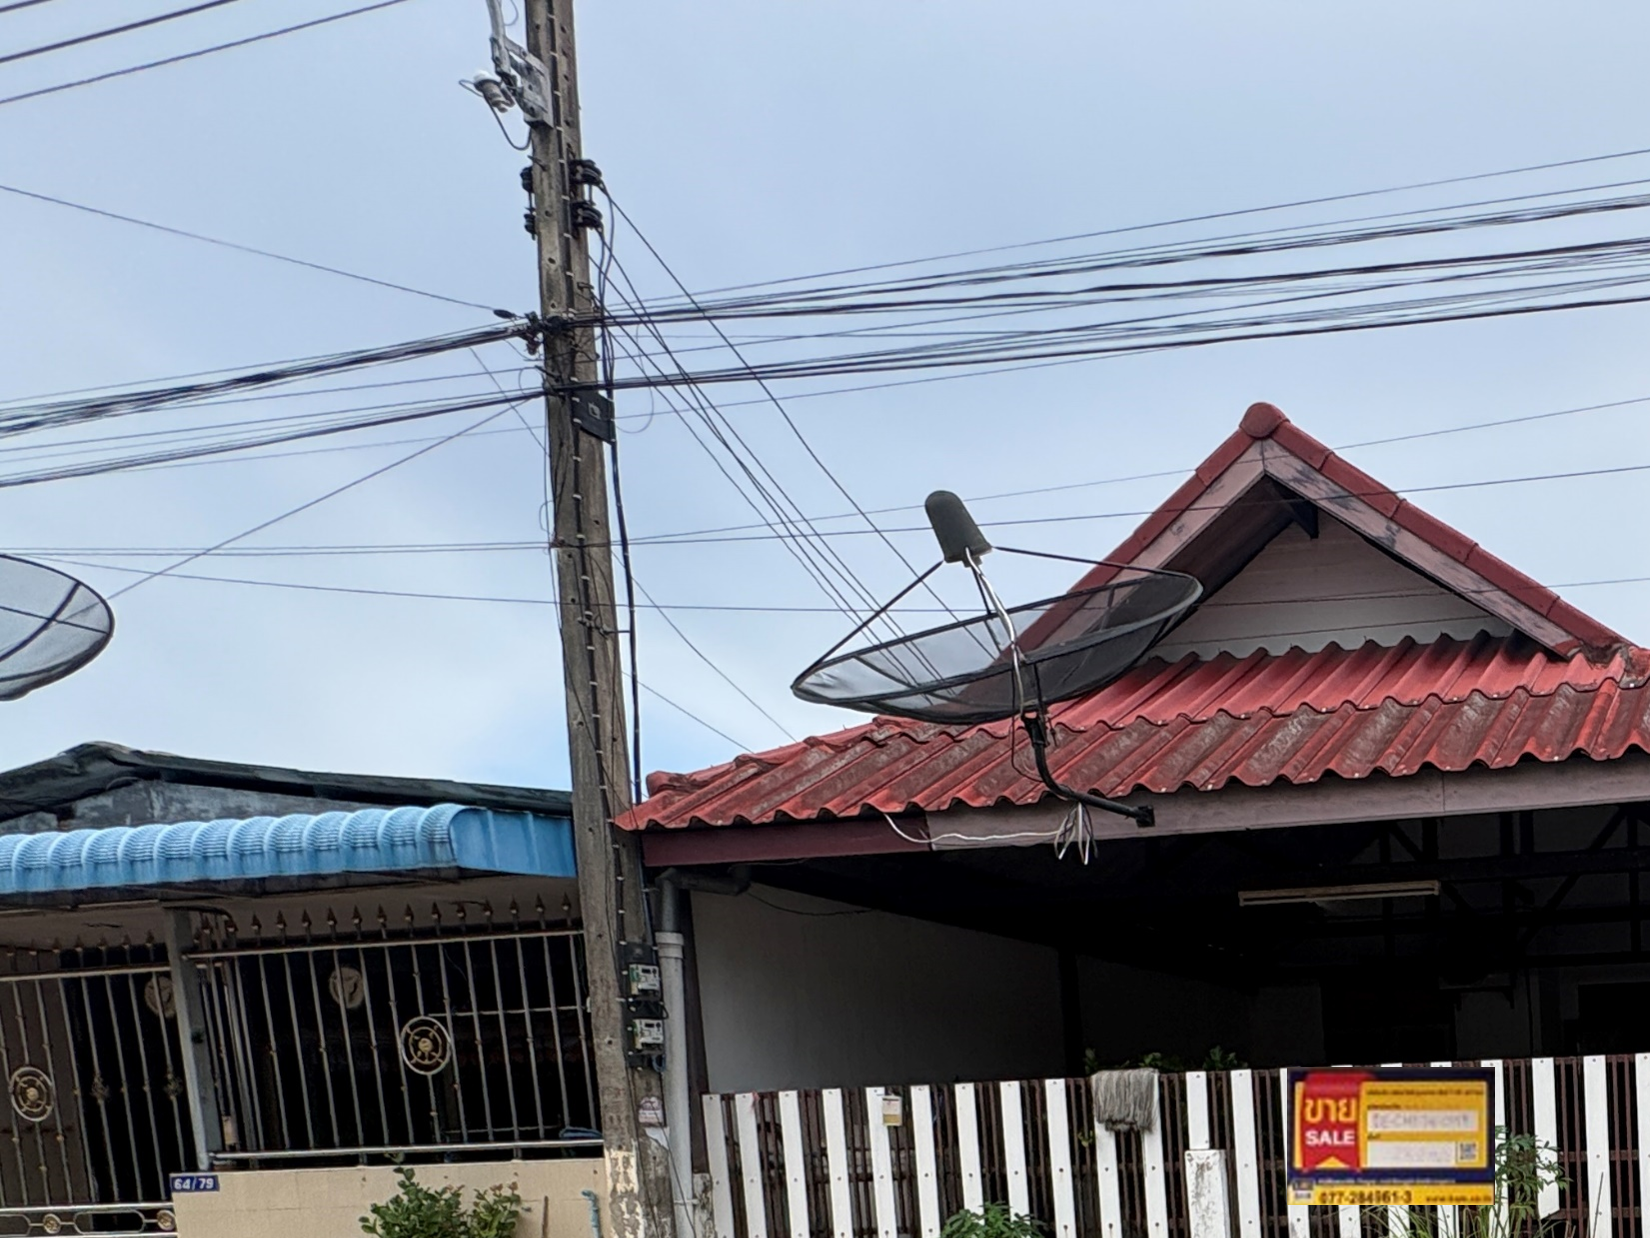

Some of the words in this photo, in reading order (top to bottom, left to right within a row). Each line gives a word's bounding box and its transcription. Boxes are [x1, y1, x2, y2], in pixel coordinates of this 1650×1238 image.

[1304, 1098, 1357, 1123] ขาย
[1305, 1130, 1355, 1146] SALE
[174, 1177, 214, 1190] 64/79
